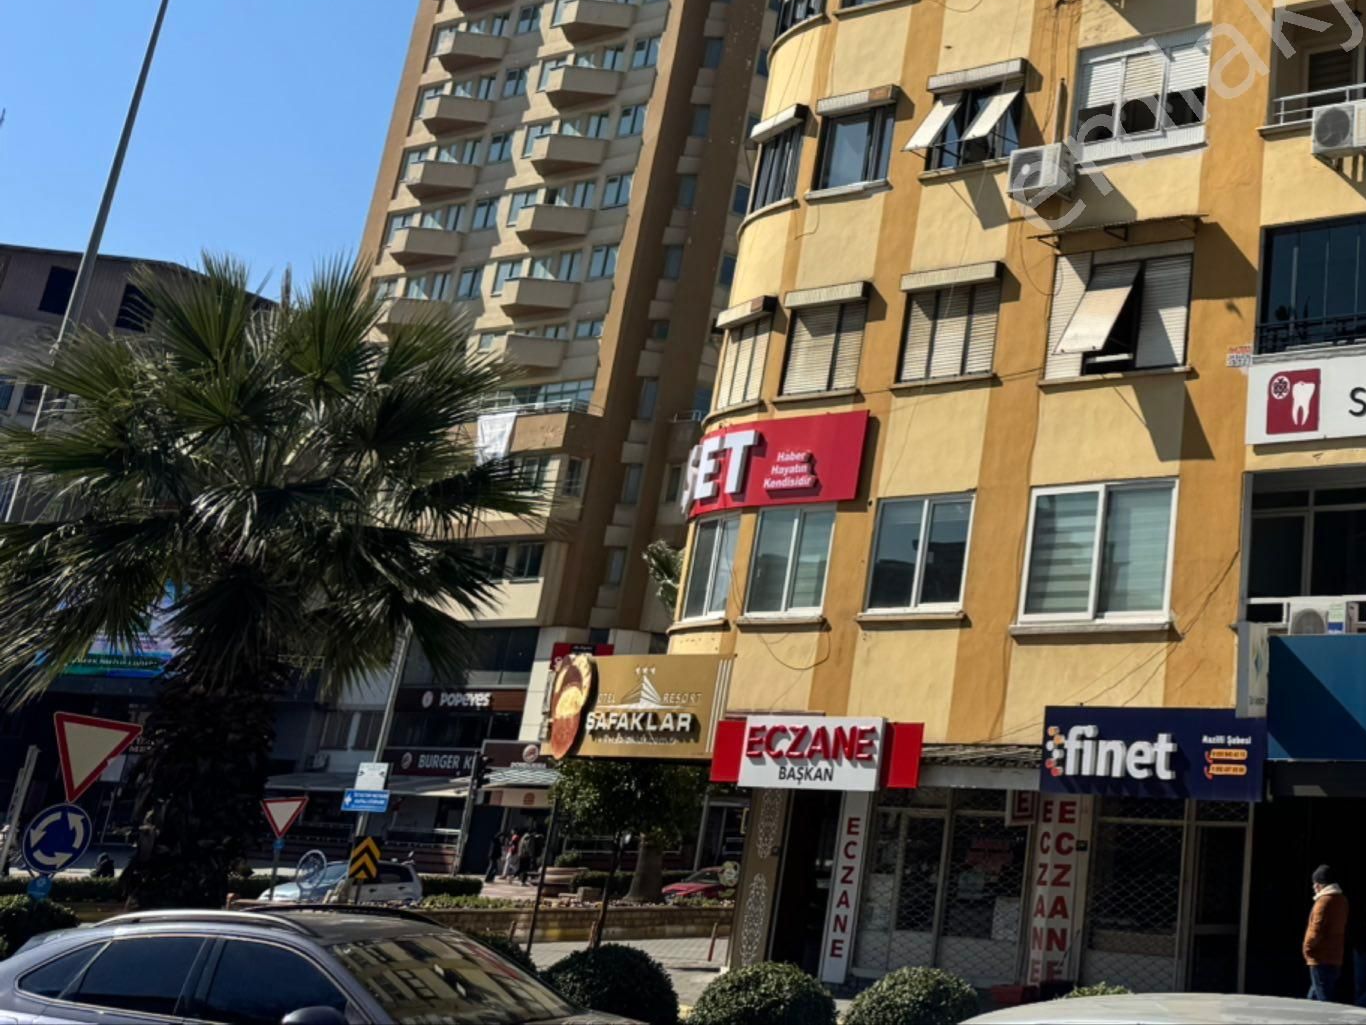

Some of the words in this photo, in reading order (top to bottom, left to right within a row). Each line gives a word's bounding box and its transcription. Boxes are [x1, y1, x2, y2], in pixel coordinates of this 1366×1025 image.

[777, 450, 807, 462] Haber
[763, 477, 812, 489] Kendisidir
[417, 753, 460, 769] BURGER
[745, 723, 879, 763] ECZANE
[1064, 724, 1178, 780] finet
[778, 765, 834, 785] BAŞKAN
[830, 817, 861, 958] ECZANE
[1030, 800, 1053, 983] ECZANE
[1046, 801, 1077, 980] ECZANE
